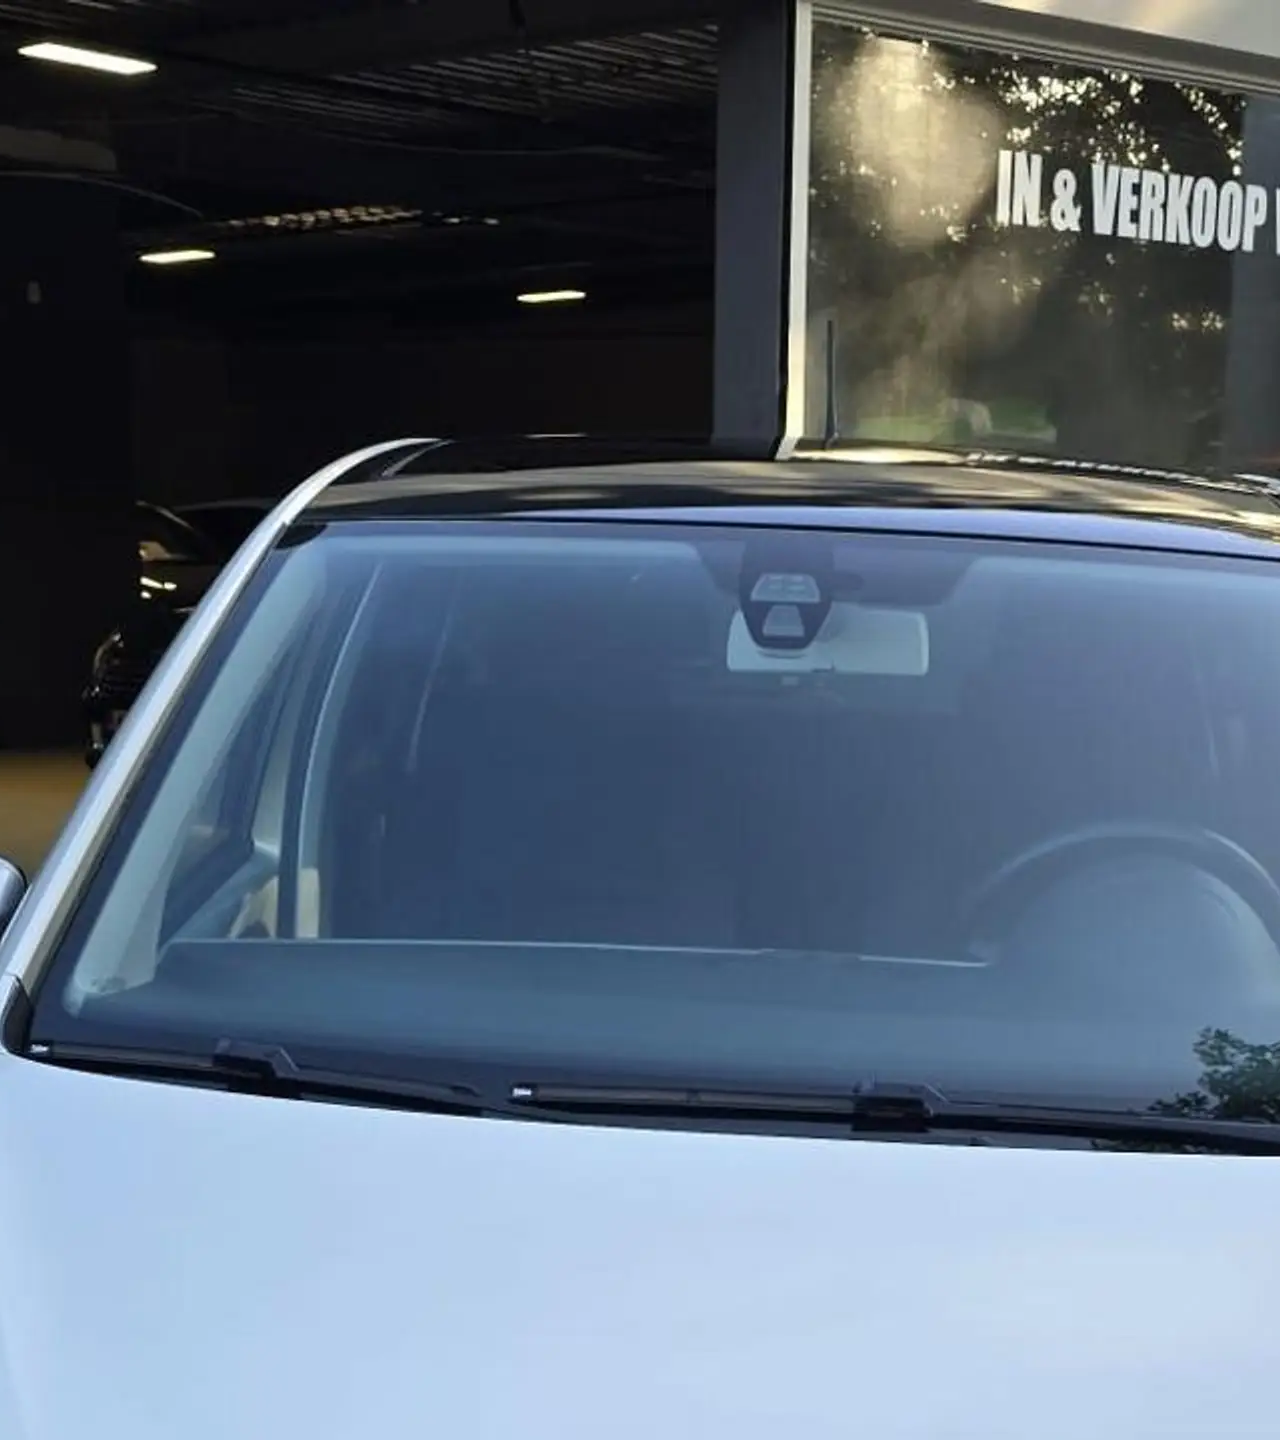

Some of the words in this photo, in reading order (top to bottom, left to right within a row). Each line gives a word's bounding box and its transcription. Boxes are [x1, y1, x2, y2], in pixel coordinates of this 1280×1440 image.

[996, 149, 1043, 227] IN
[1050, 168, 1082, 232] &
[1091, 160, 1268, 252] VERKOOP
